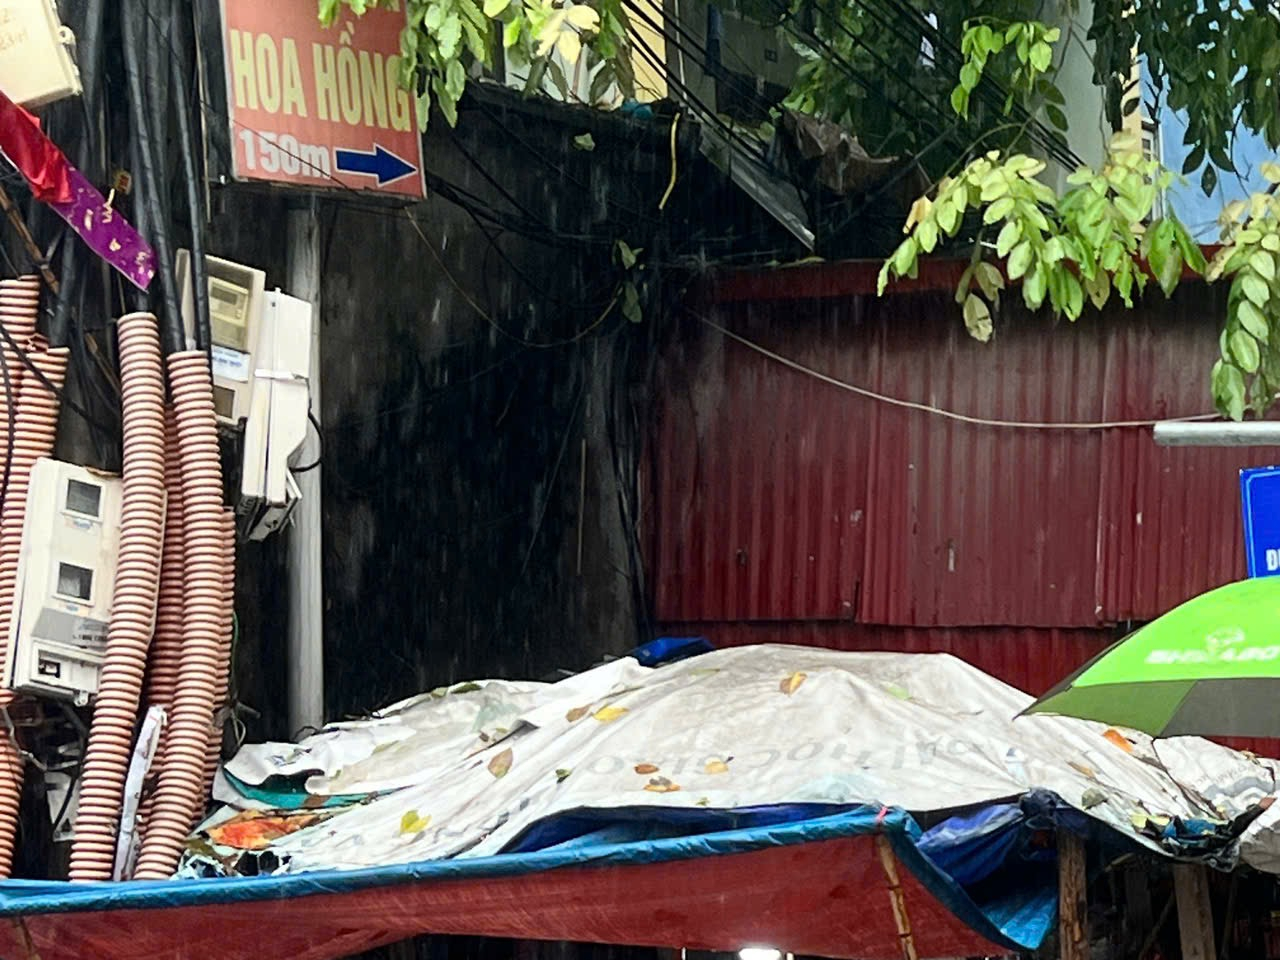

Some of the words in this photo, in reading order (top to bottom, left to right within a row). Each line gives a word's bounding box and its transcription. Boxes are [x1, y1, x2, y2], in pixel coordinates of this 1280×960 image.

[230, 28, 307, 118] HOA
[312, 21, 411, 132] HỒNG
[239, 128, 331, 180] 150m
